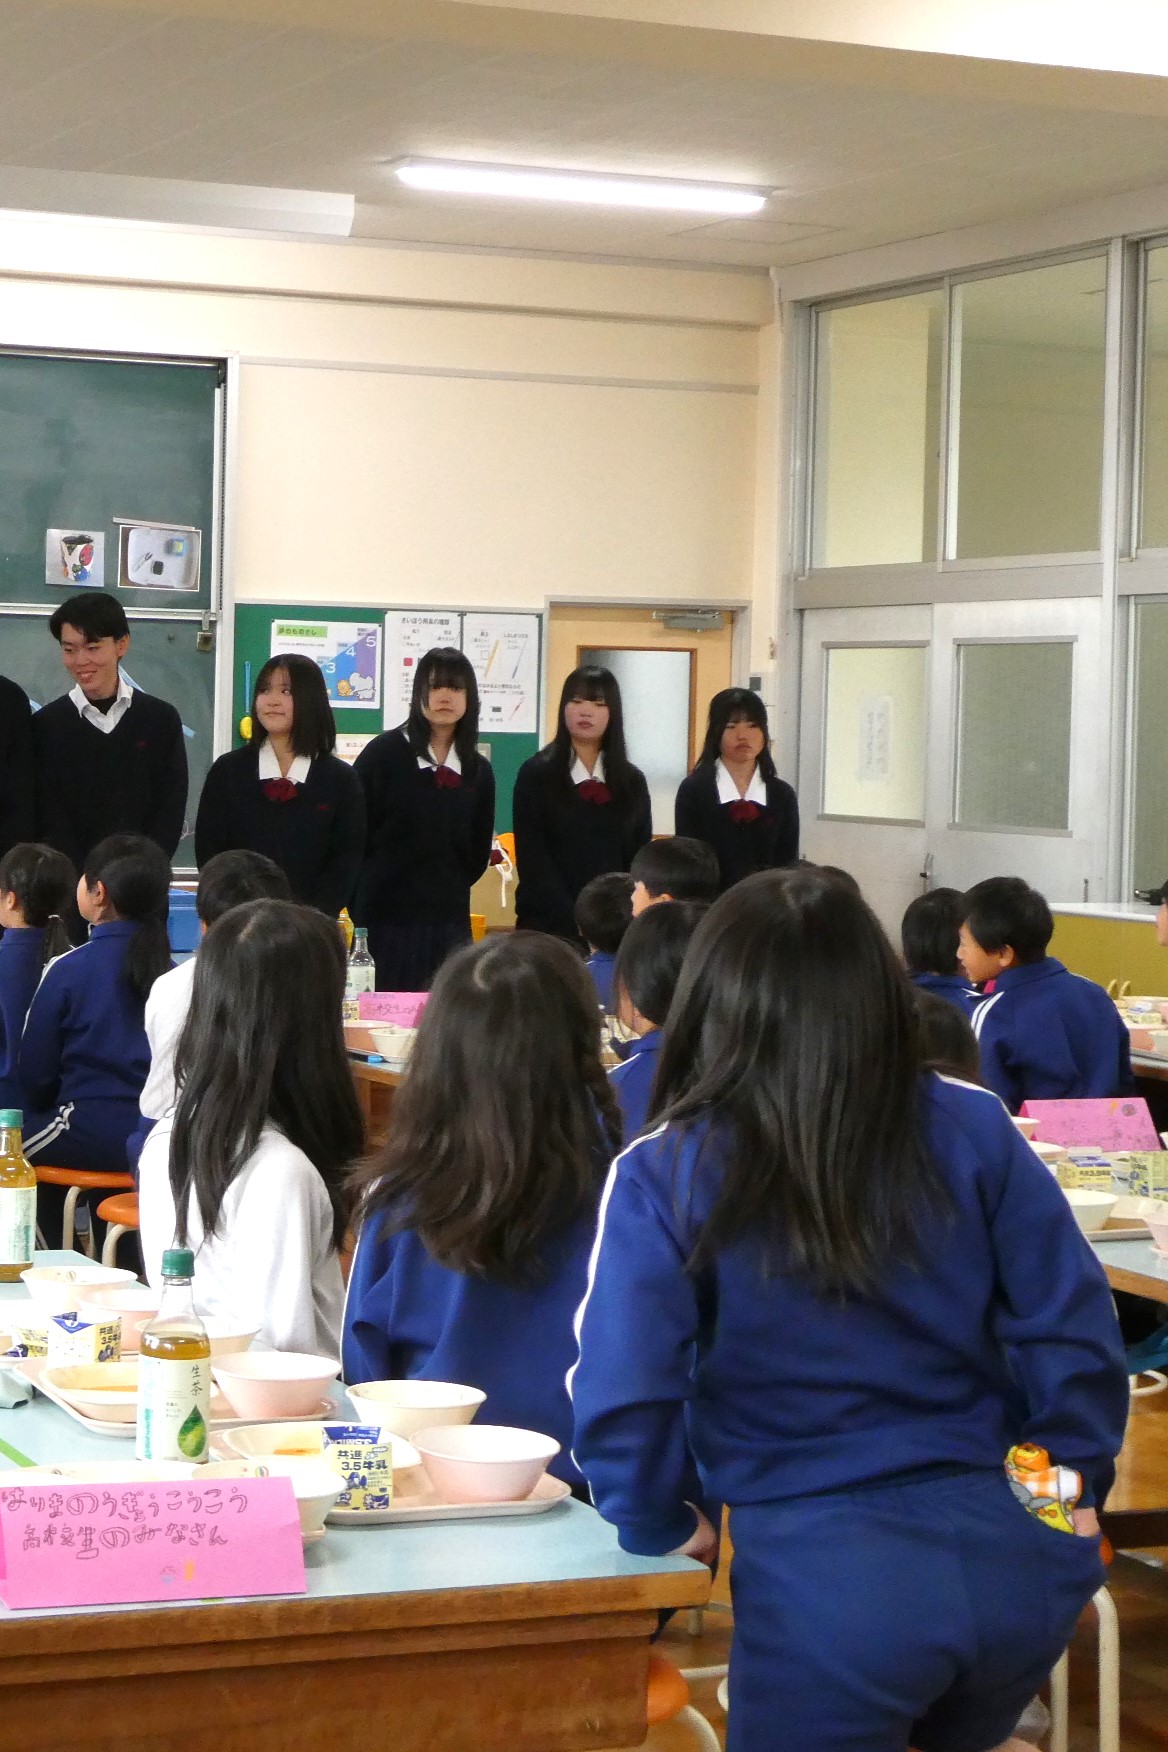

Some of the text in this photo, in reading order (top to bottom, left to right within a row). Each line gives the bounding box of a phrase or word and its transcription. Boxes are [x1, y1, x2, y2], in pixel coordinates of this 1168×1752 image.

[366, 635, 377, 648] 5
[345, 646, 356, 657] 4
[325, 662, 336, 674] 3
[190, 1364, 203, 1397] 生茶
[22, 1523, 229, 1560] 高校生のみなさん
